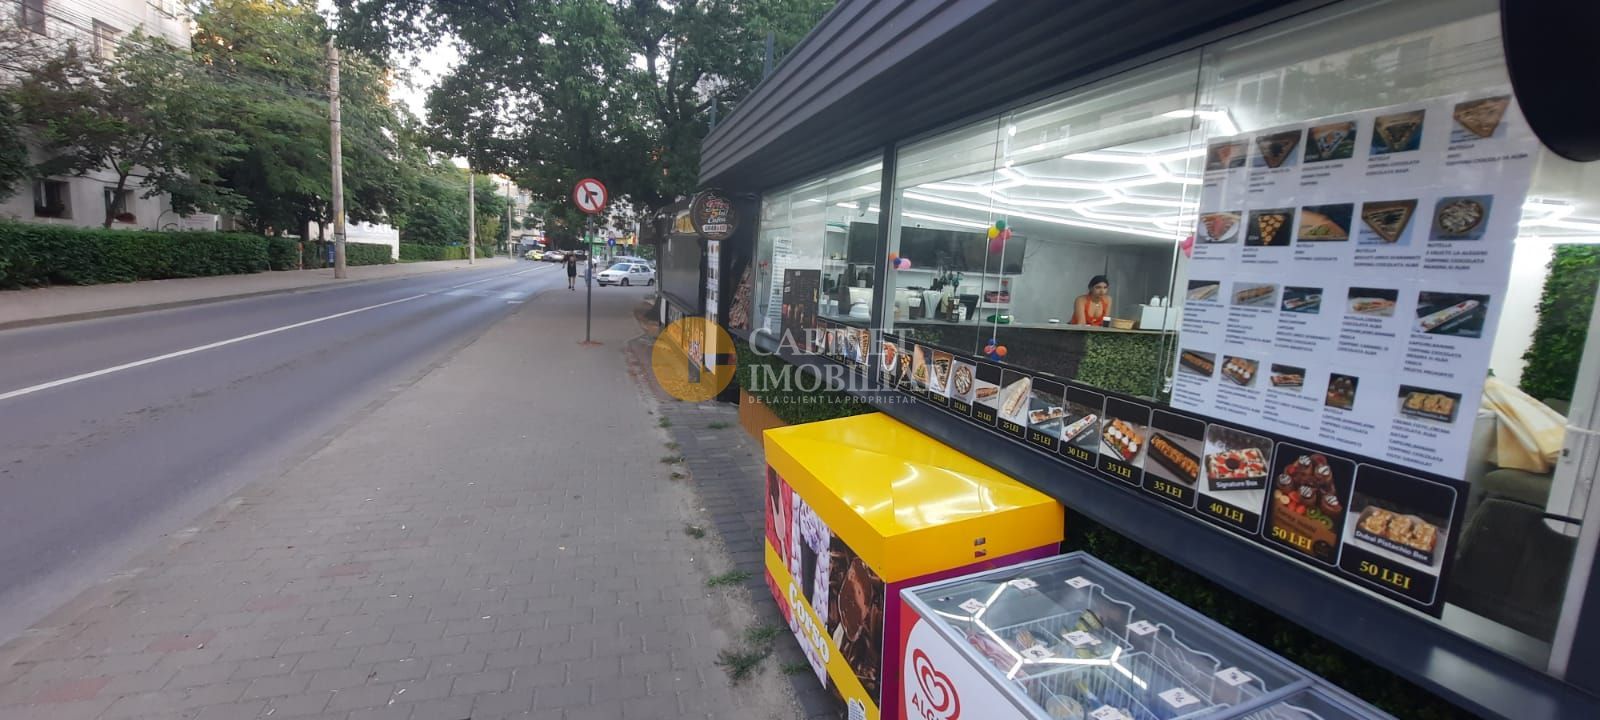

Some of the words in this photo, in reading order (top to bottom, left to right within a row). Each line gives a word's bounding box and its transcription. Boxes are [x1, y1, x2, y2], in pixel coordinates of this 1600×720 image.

[1010, 423, 1018, 432] LEI
[1040, 436, 1051, 446] LEI
[1067, 446, 1076, 456] 30
[1076, 450, 1088, 460] LEI
[1107, 462, 1116, 472] 35
[1117, 464, 1132, 478] LEI
[1154, 480, 1164, 491] 35
[1166, 484, 1182, 499] LEI
[1210, 502, 1222, 514] 40
[1224, 508, 1244, 523] LEI
[1272, 526, 1287, 540] 50
[1288, 532, 1312, 550] LEI
[1378, 538, 1412, 555] Pistachio
[1360, 560, 1378, 576] 50
[1382, 568, 1412, 590] LEI
